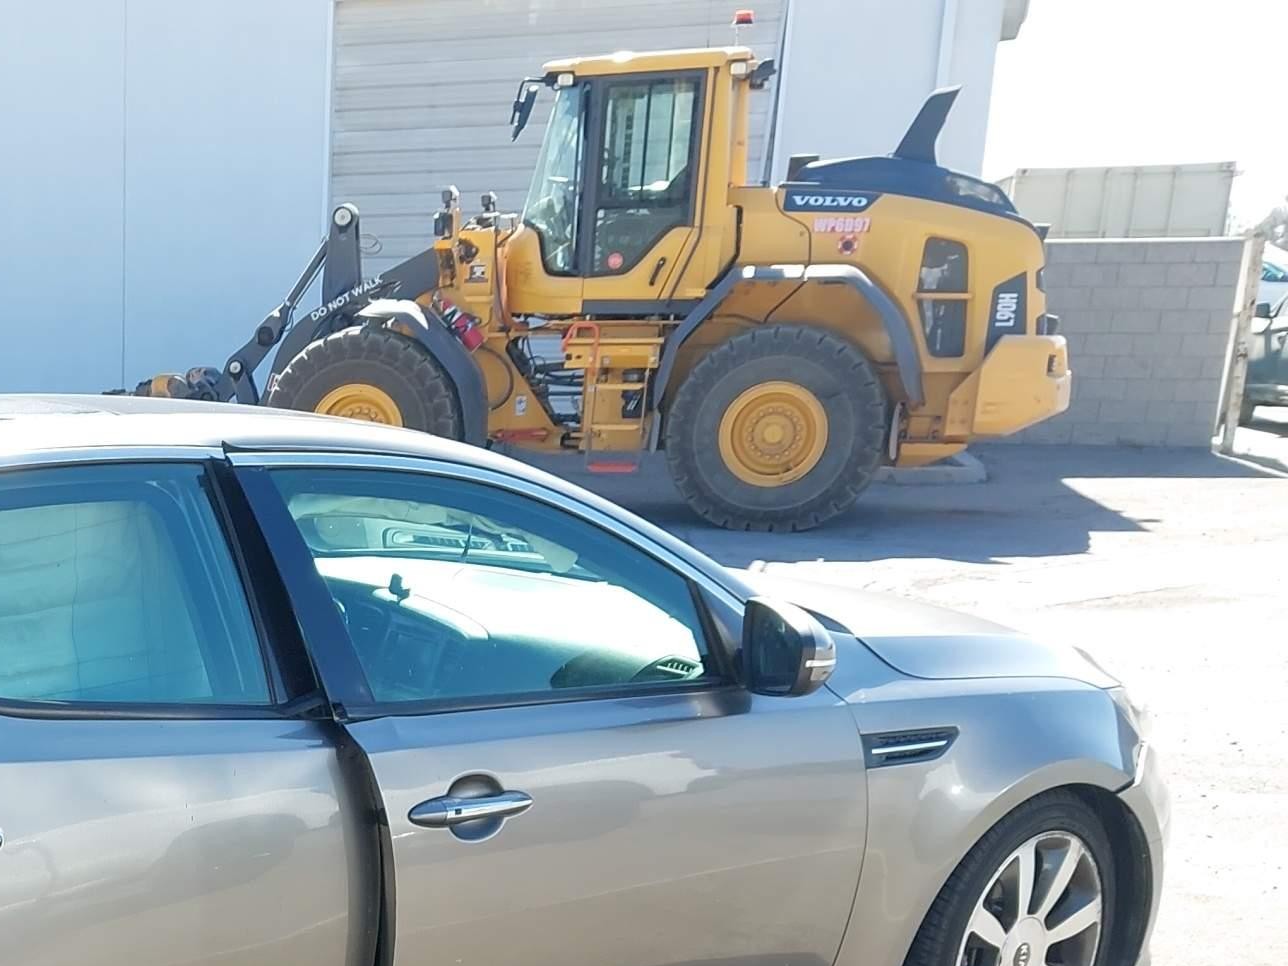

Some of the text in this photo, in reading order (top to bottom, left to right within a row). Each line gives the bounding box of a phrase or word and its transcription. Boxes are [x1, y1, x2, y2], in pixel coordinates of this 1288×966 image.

[792, 195, 868, 207] VOLVO
[311, 272, 383, 320] DO NOT WALK
[994, 293, 1018, 327] L90H
